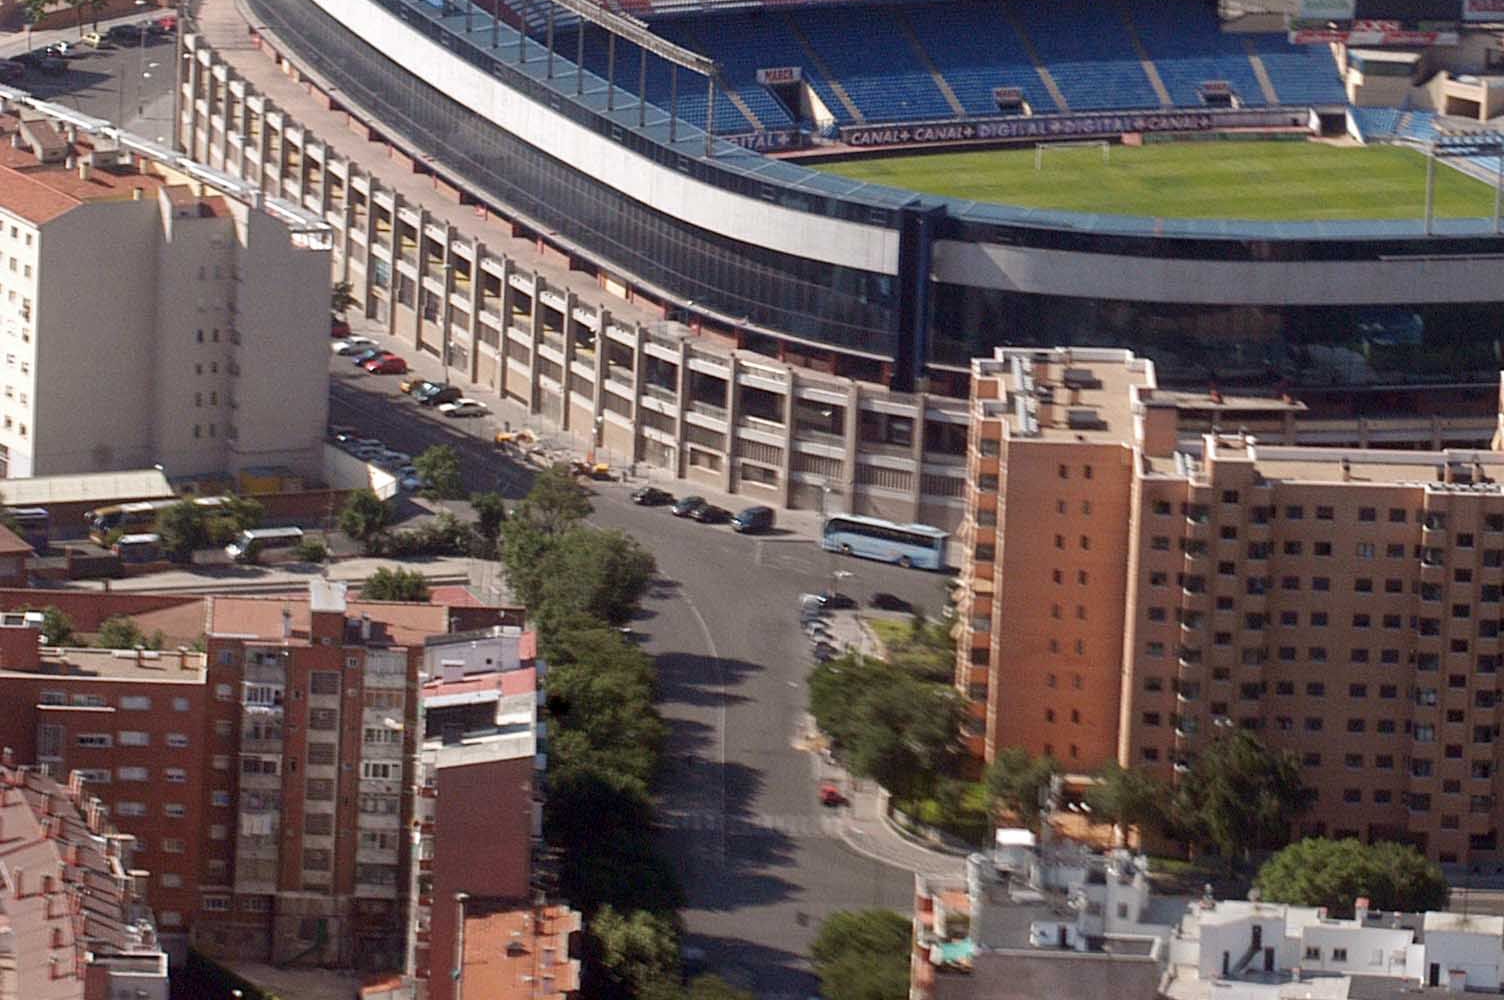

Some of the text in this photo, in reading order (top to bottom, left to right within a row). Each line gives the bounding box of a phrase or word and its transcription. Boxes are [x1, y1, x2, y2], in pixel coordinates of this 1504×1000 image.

[765, 69, 793, 82] MARCA
[851, 130, 911, 145] CANAL+
[914, 125, 975, 142] CANAL+
